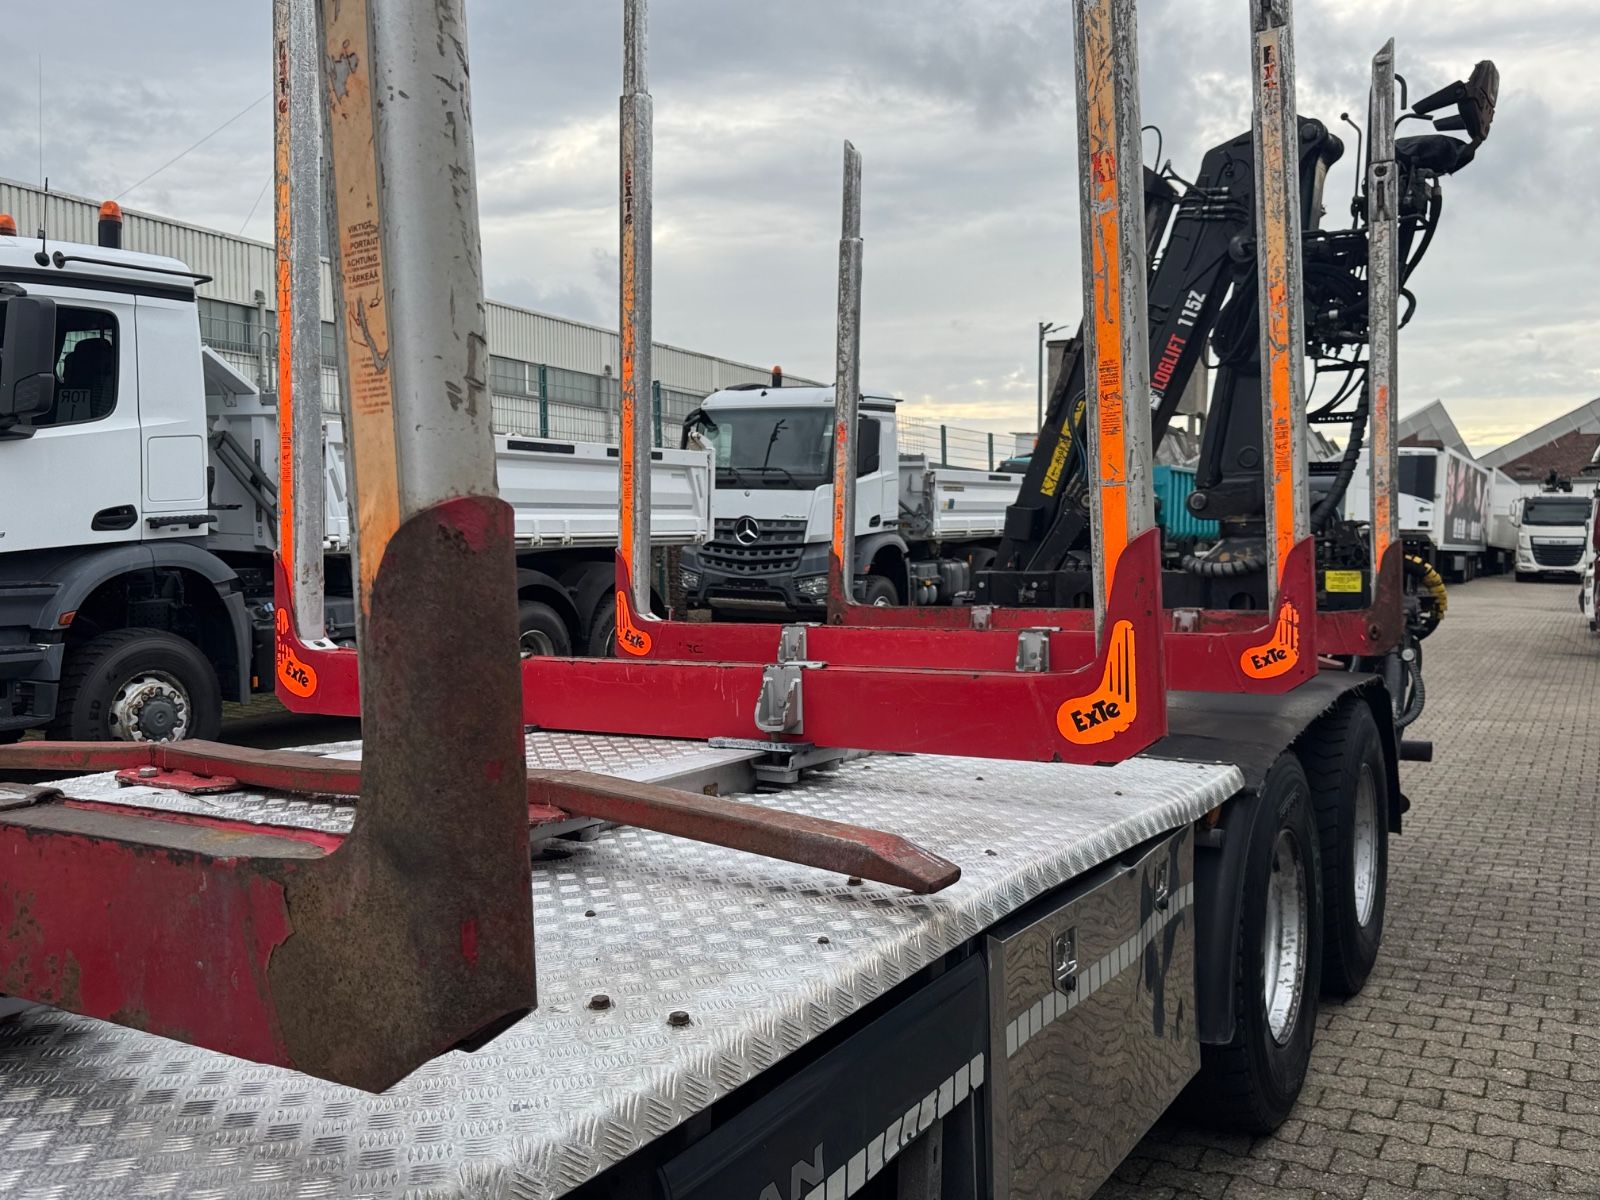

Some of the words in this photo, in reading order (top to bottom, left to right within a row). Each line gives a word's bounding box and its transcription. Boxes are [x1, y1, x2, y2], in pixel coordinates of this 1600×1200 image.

[347, 254, 378, 268] ACHTUNG
[1150, 333, 1186, 390] LOGLIFT
[1177, 289, 1207, 327] 115Z
[624, 629, 645, 649] ExTe
[1251, 647, 1287, 670] ExTe
[285, 660, 309, 688] ExTe
[1070, 699, 1120, 733] ExTe
